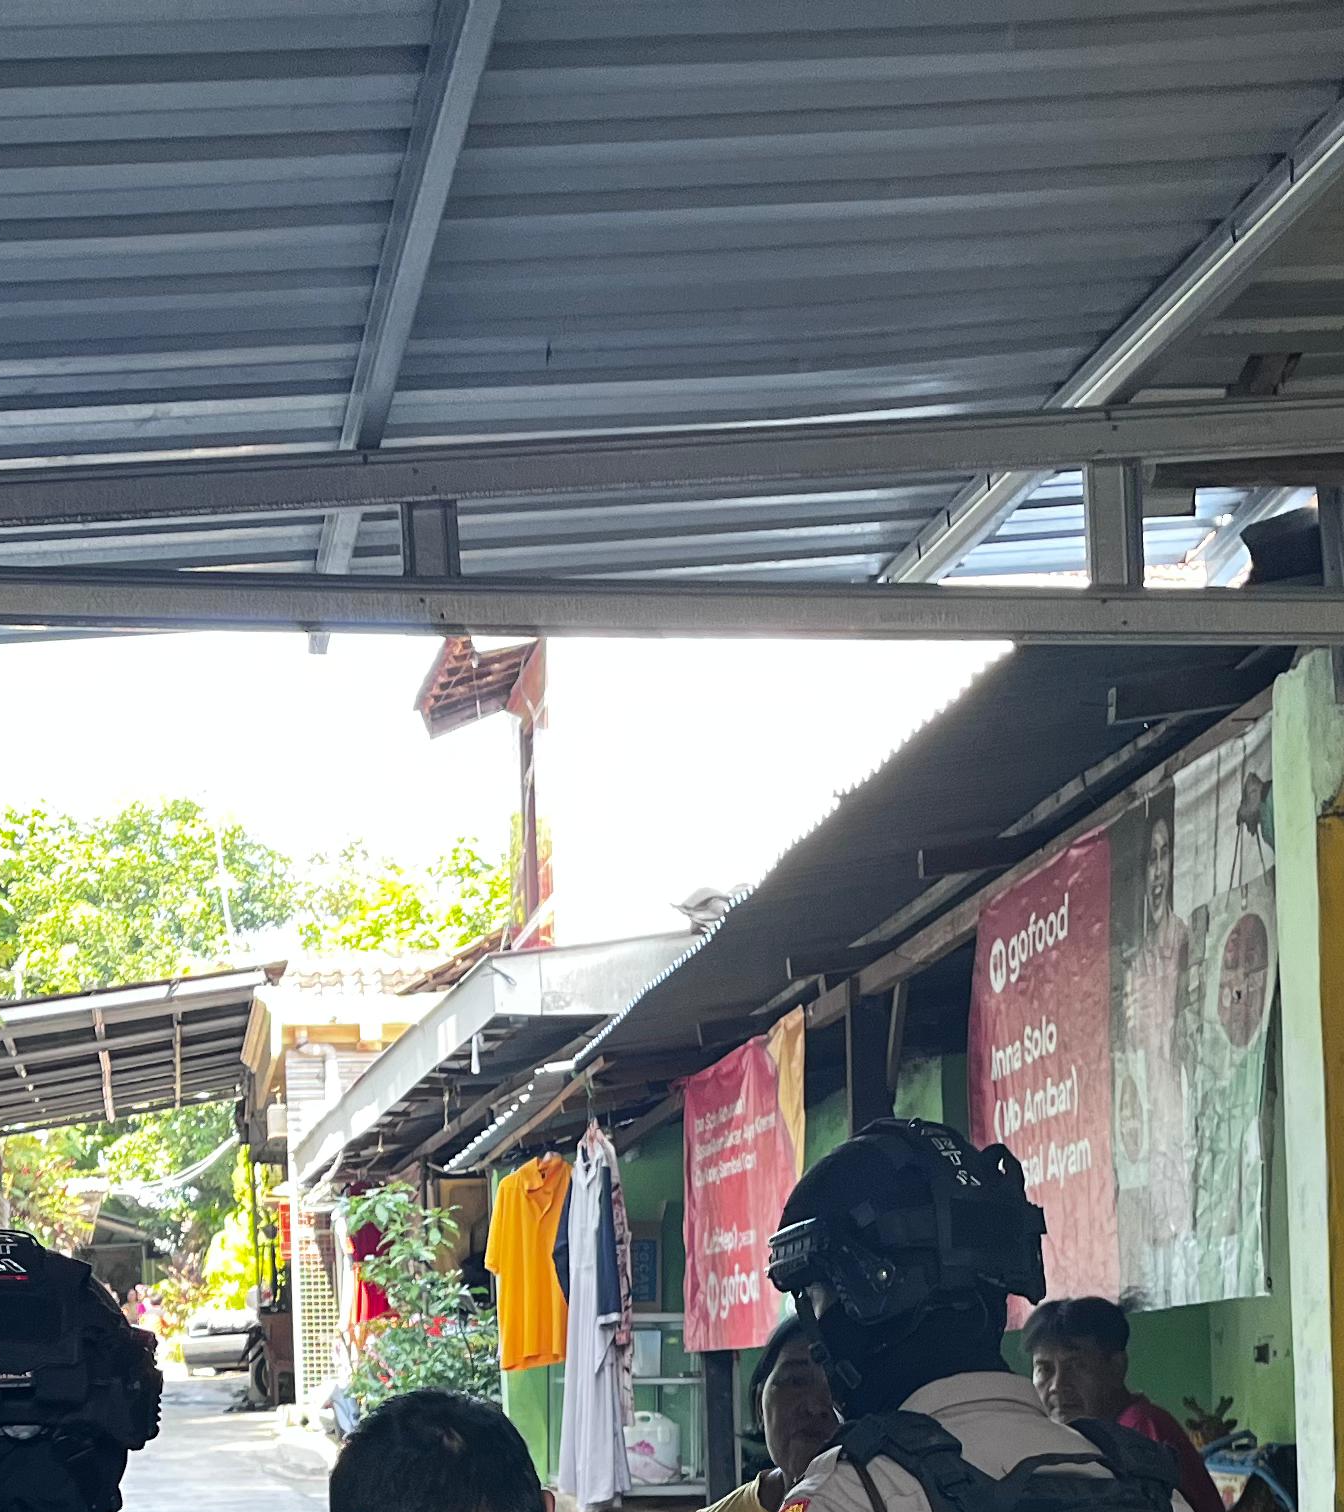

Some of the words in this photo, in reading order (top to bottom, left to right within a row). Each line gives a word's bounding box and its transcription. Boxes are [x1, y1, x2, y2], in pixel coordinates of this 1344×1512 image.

[1008, 891, 1069, 984] gofood
[1024, 1015, 1057, 1064] Solo
[1047, 1137, 1092, 1190] Ayam
